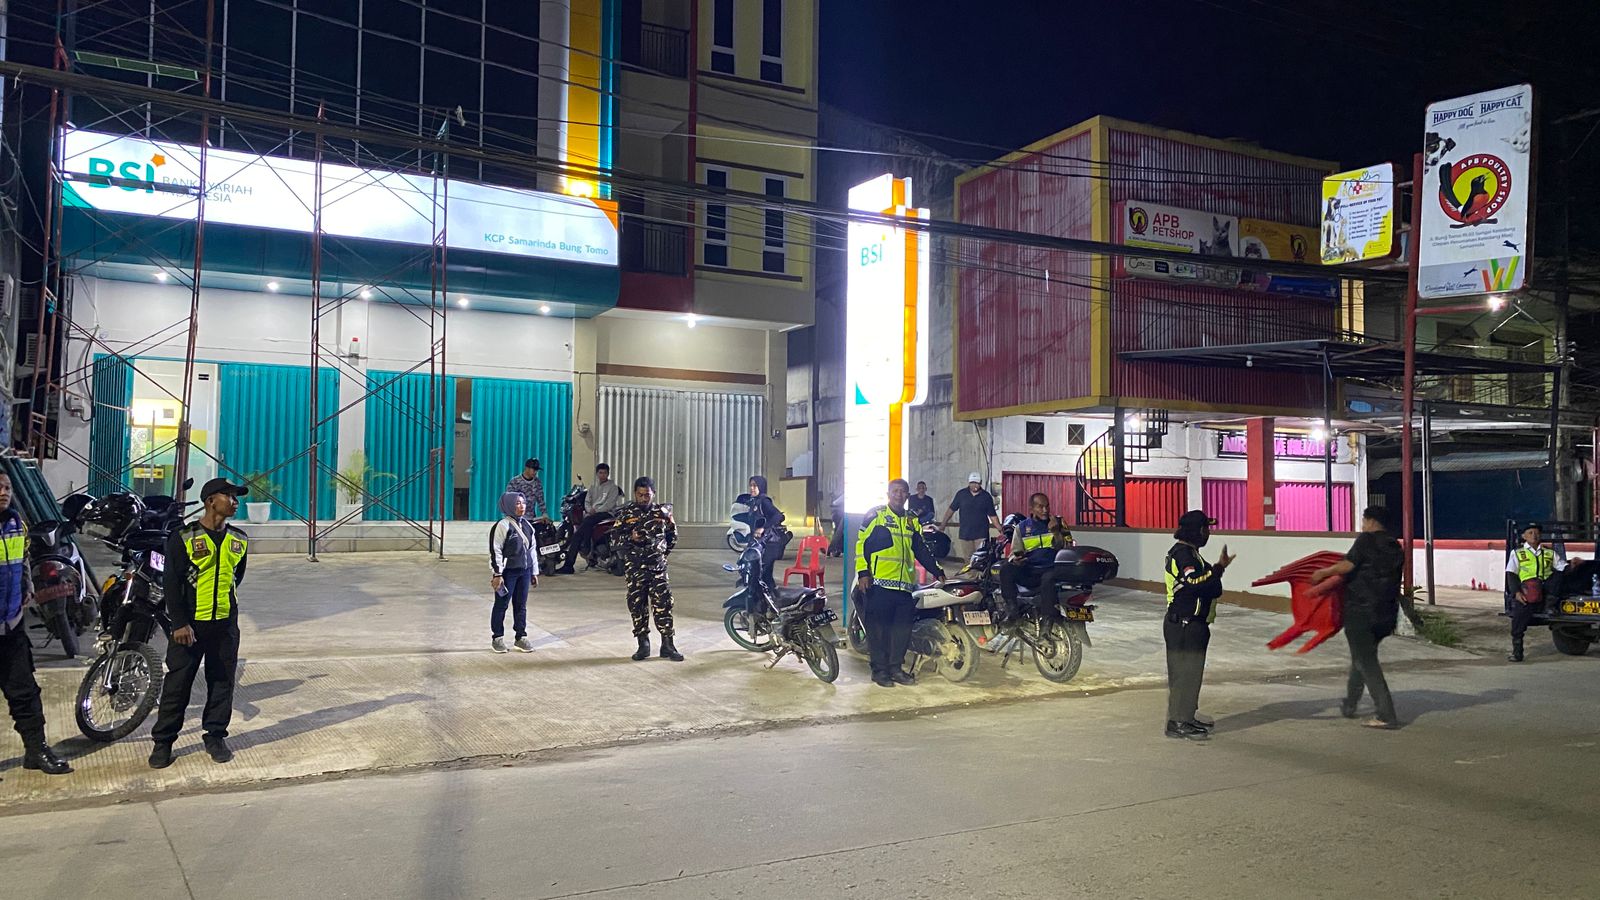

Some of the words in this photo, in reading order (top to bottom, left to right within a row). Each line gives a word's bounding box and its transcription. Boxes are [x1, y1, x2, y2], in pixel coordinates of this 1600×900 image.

[1480, 101, 1505, 114] HAPPY
[1506, 95, 1523, 107] CAT
[1433, 111, 1457, 124] HAPPY
[1458, 106, 1474, 117] DOG
[1461, 158, 1480, 169] APB
[1482, 157, 1508, 188] POULTRY
[88, 157, 155, 194] BSI
[202, 181, 253, 196] YARIAH
[1486, 191, 1506, 213] SHOP
[1152, 213, 1180, 229] APB
[1152, 226, 1195, 240] PETSHOP
[484, 233, 505, 243] KCP
[508, 235, 557, 249] Samarinda
[559, 241, 582, 254] Bung
[585, 244, 609, 255] Tomo
[861, 243, 882, 266] BSI
